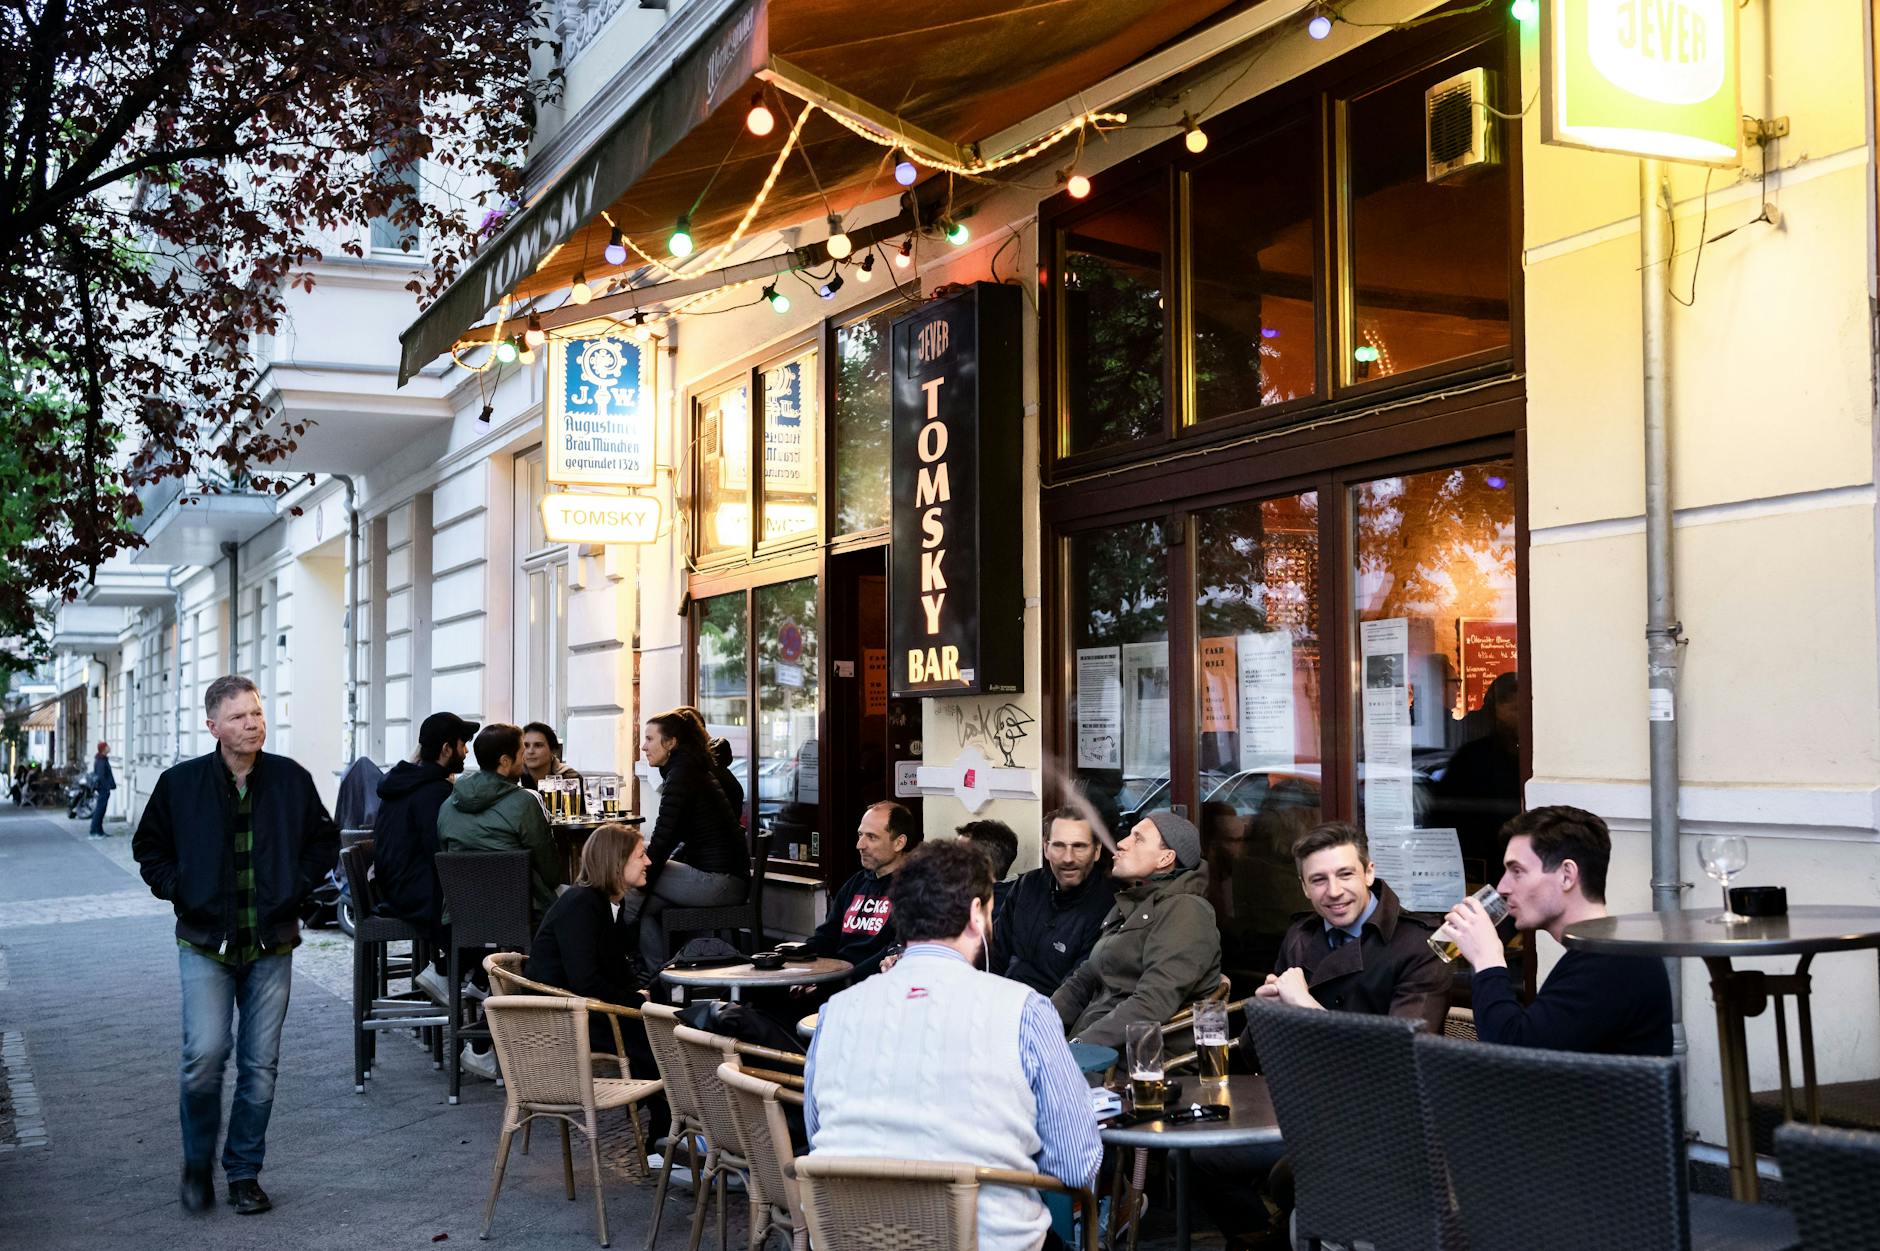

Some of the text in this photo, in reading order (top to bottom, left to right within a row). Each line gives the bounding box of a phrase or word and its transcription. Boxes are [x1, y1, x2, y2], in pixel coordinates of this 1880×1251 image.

[1617, 0, 1708, 63] JEVER
[918, 320, 949, 362] JEVER
[565, 434, 591, 451] Bräu
[565, 457, 616, 470] gegründet
[560, 509, 646, 528] TOMSKY
[915, 376, 951, 635] TOMSKY
[908, 645, 961, 684] BAR
[843, 915, 884, 931] JONES
